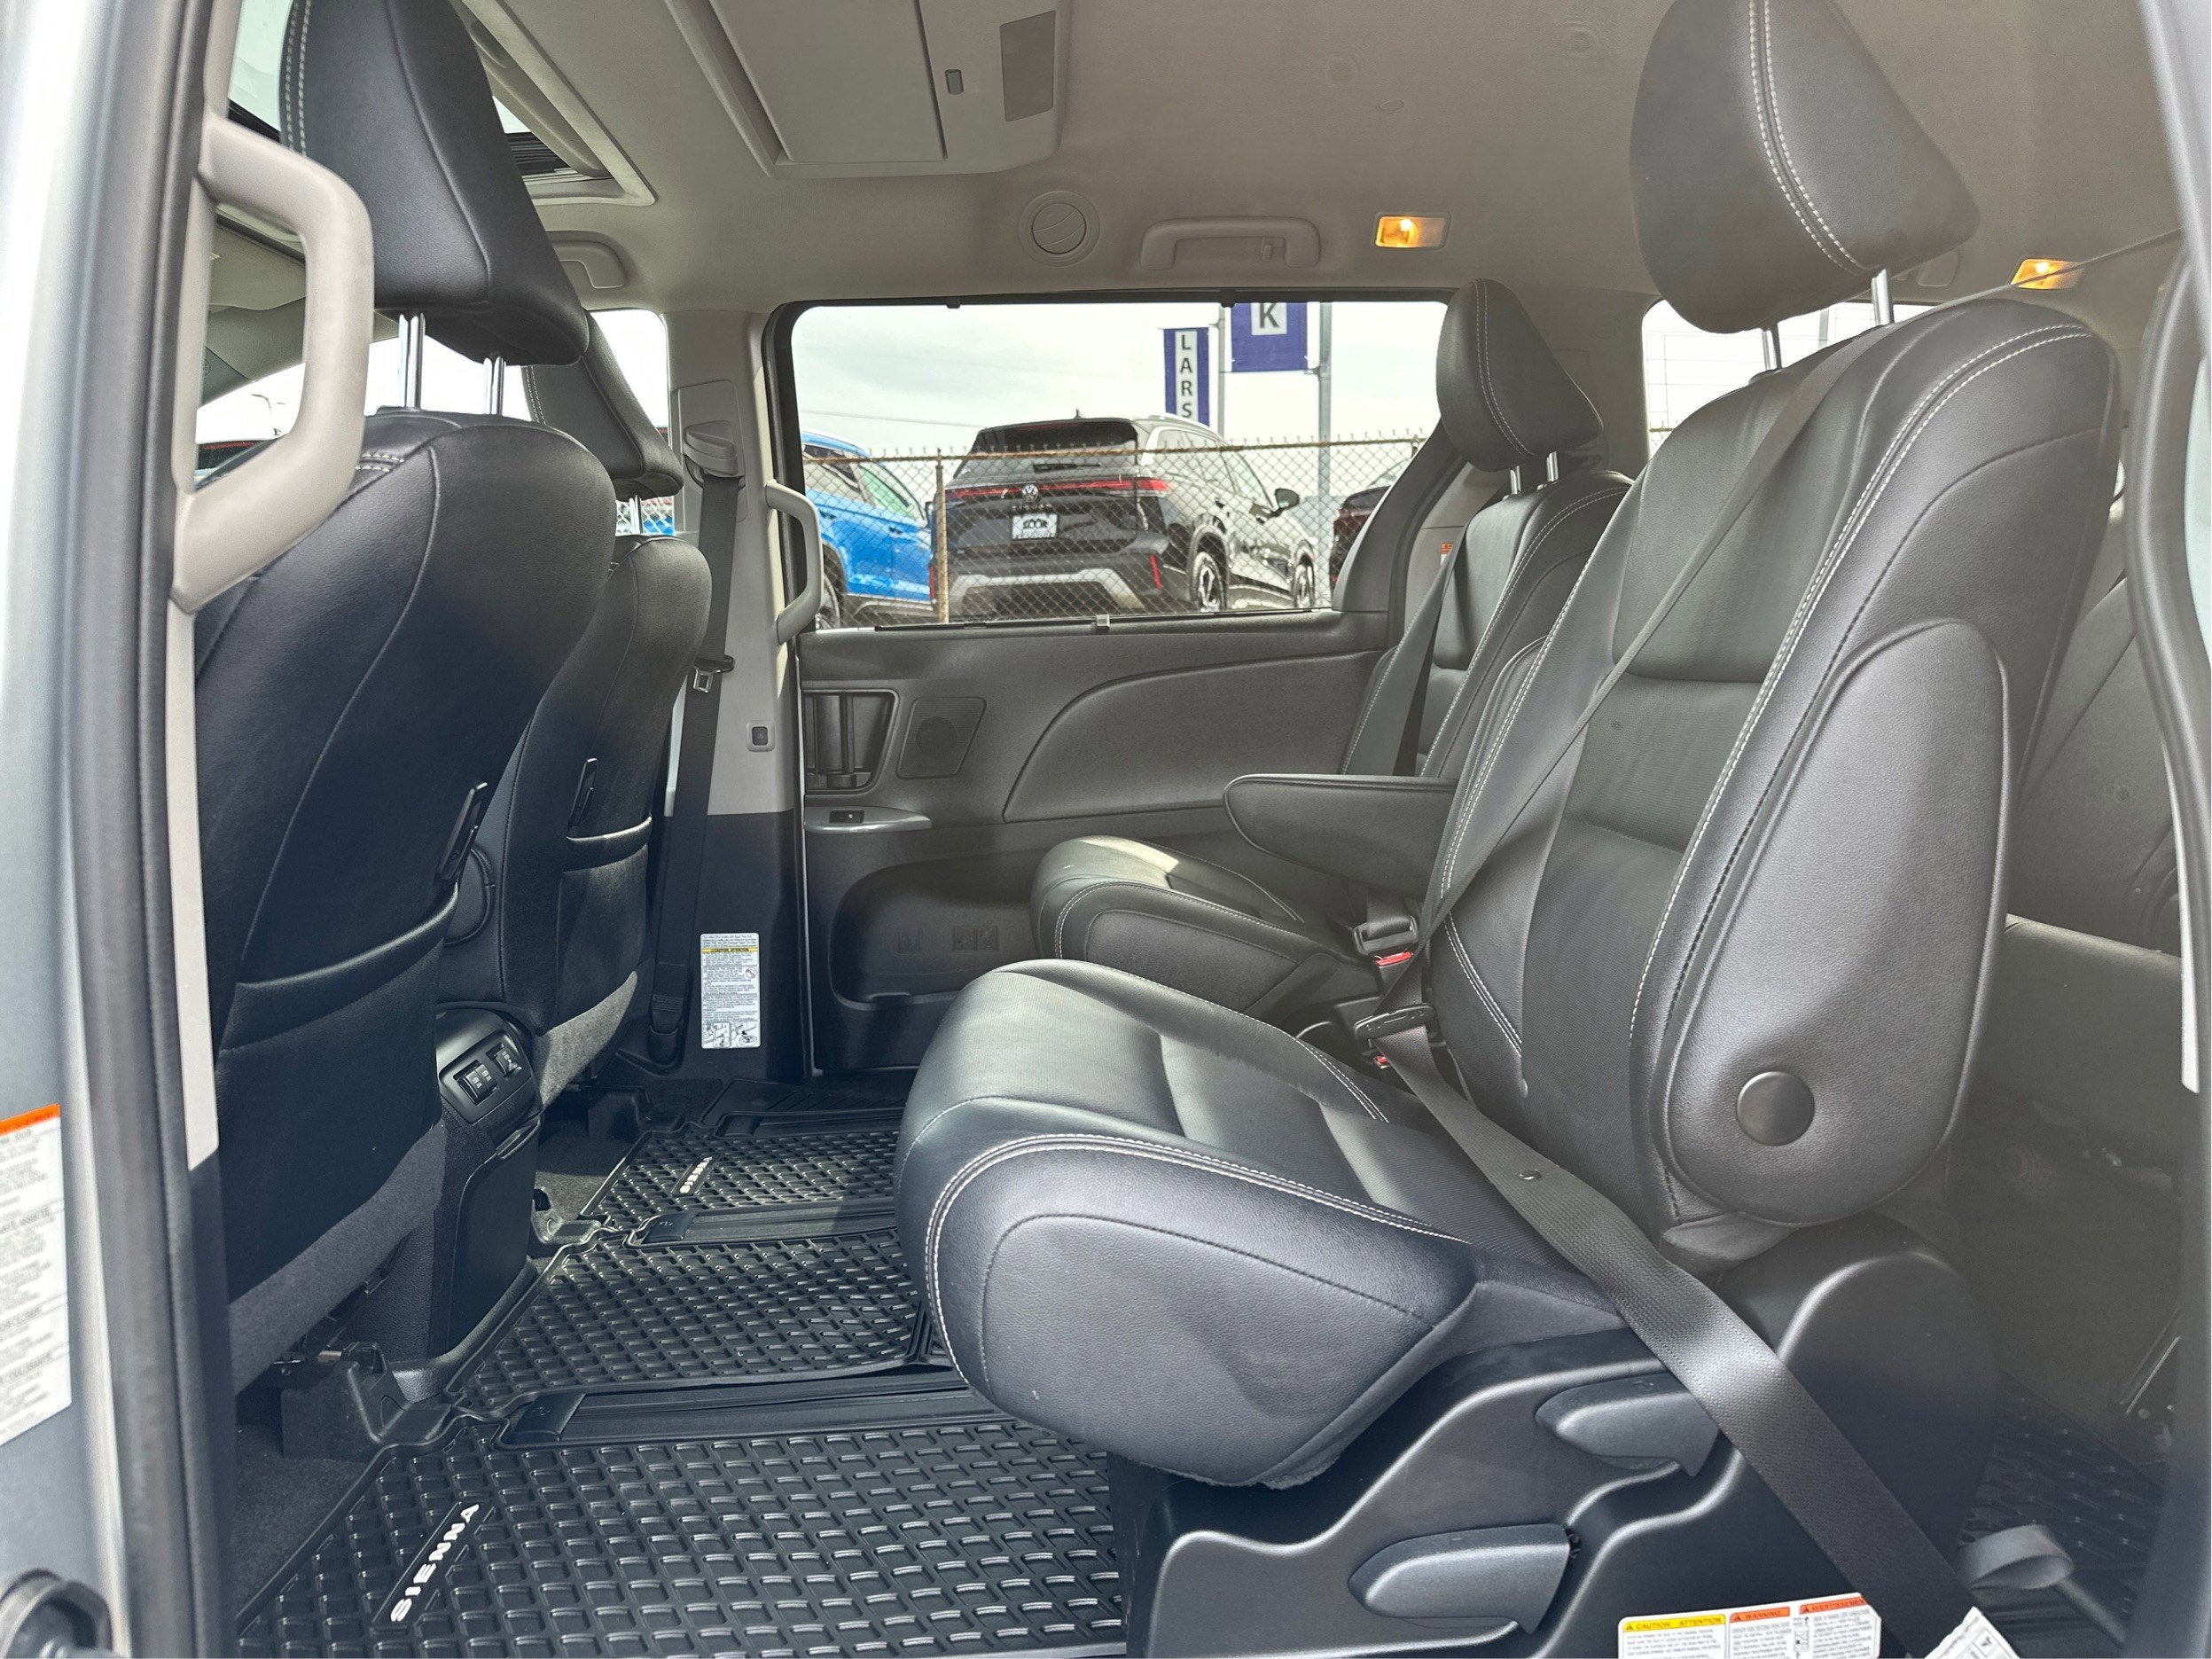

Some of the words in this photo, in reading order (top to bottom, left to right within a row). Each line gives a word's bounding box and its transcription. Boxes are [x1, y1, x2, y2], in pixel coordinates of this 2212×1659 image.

[1259, 302, 1279, 329] K
[1180, 334, 1193, 418] LARS
[390, 1504, 480, 1622] SIENNA
[1680, 1616, 1721, 1626] ATTENTION
[1745, 1609, 1781, 1619] WARNING
